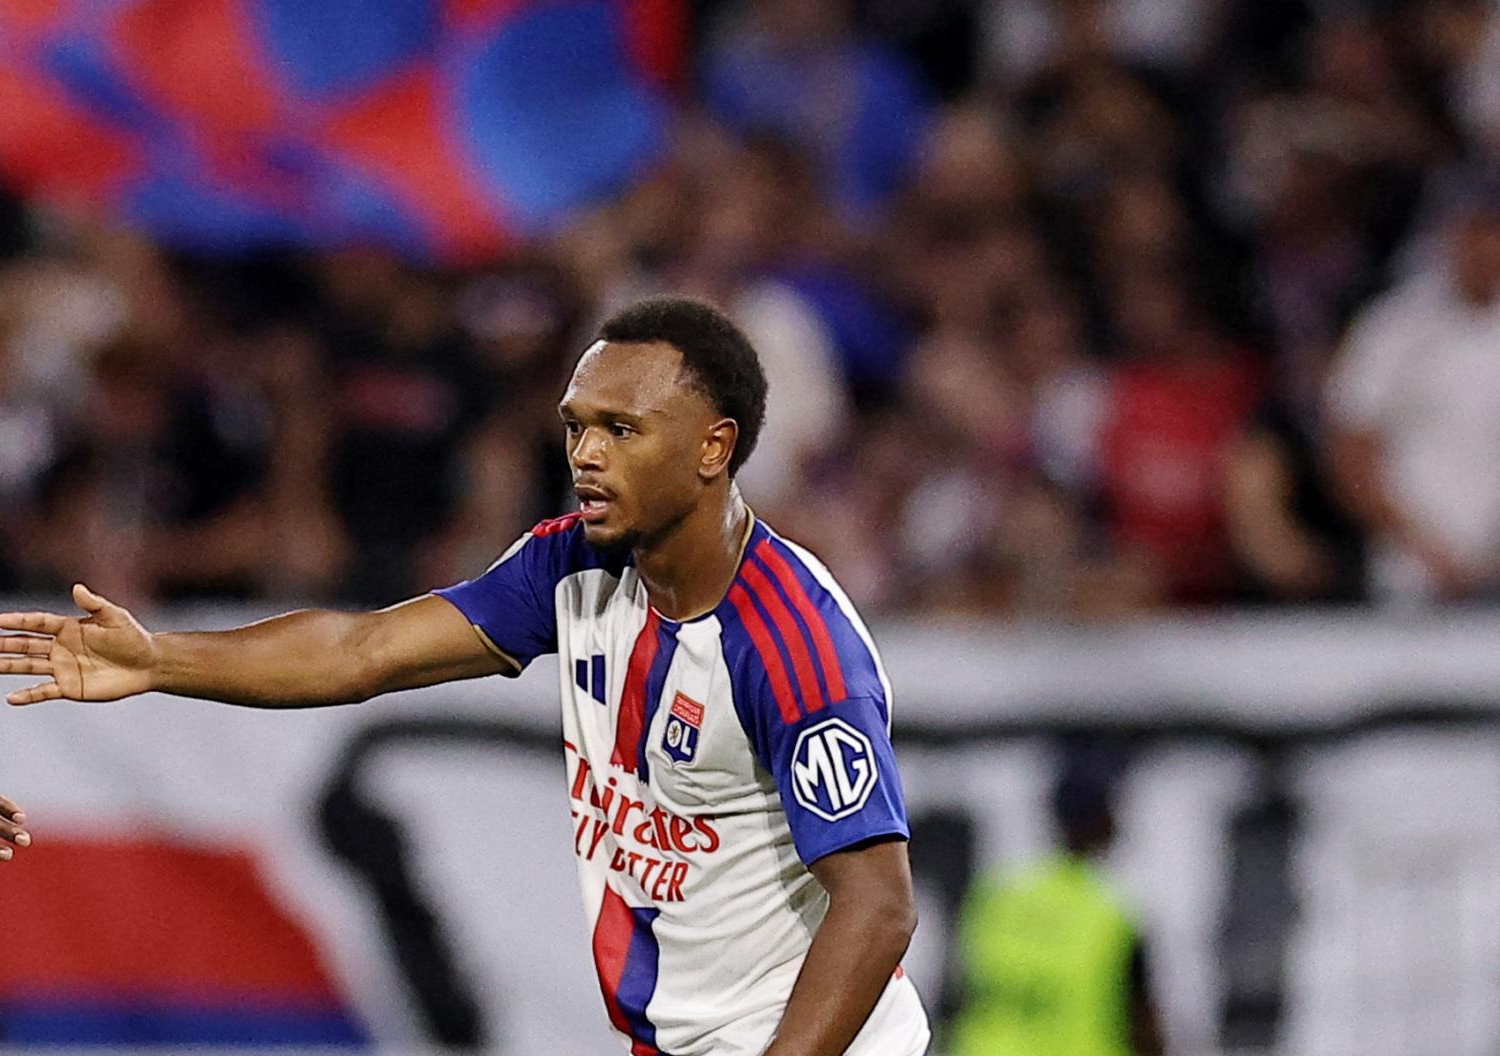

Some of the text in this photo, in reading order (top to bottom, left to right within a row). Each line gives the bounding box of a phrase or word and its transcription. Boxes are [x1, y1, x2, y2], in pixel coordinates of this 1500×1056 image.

[666, 719, 693, 757] OL
[794, 727, 869, 812] MG
[571, 808, 610, 861] LY
